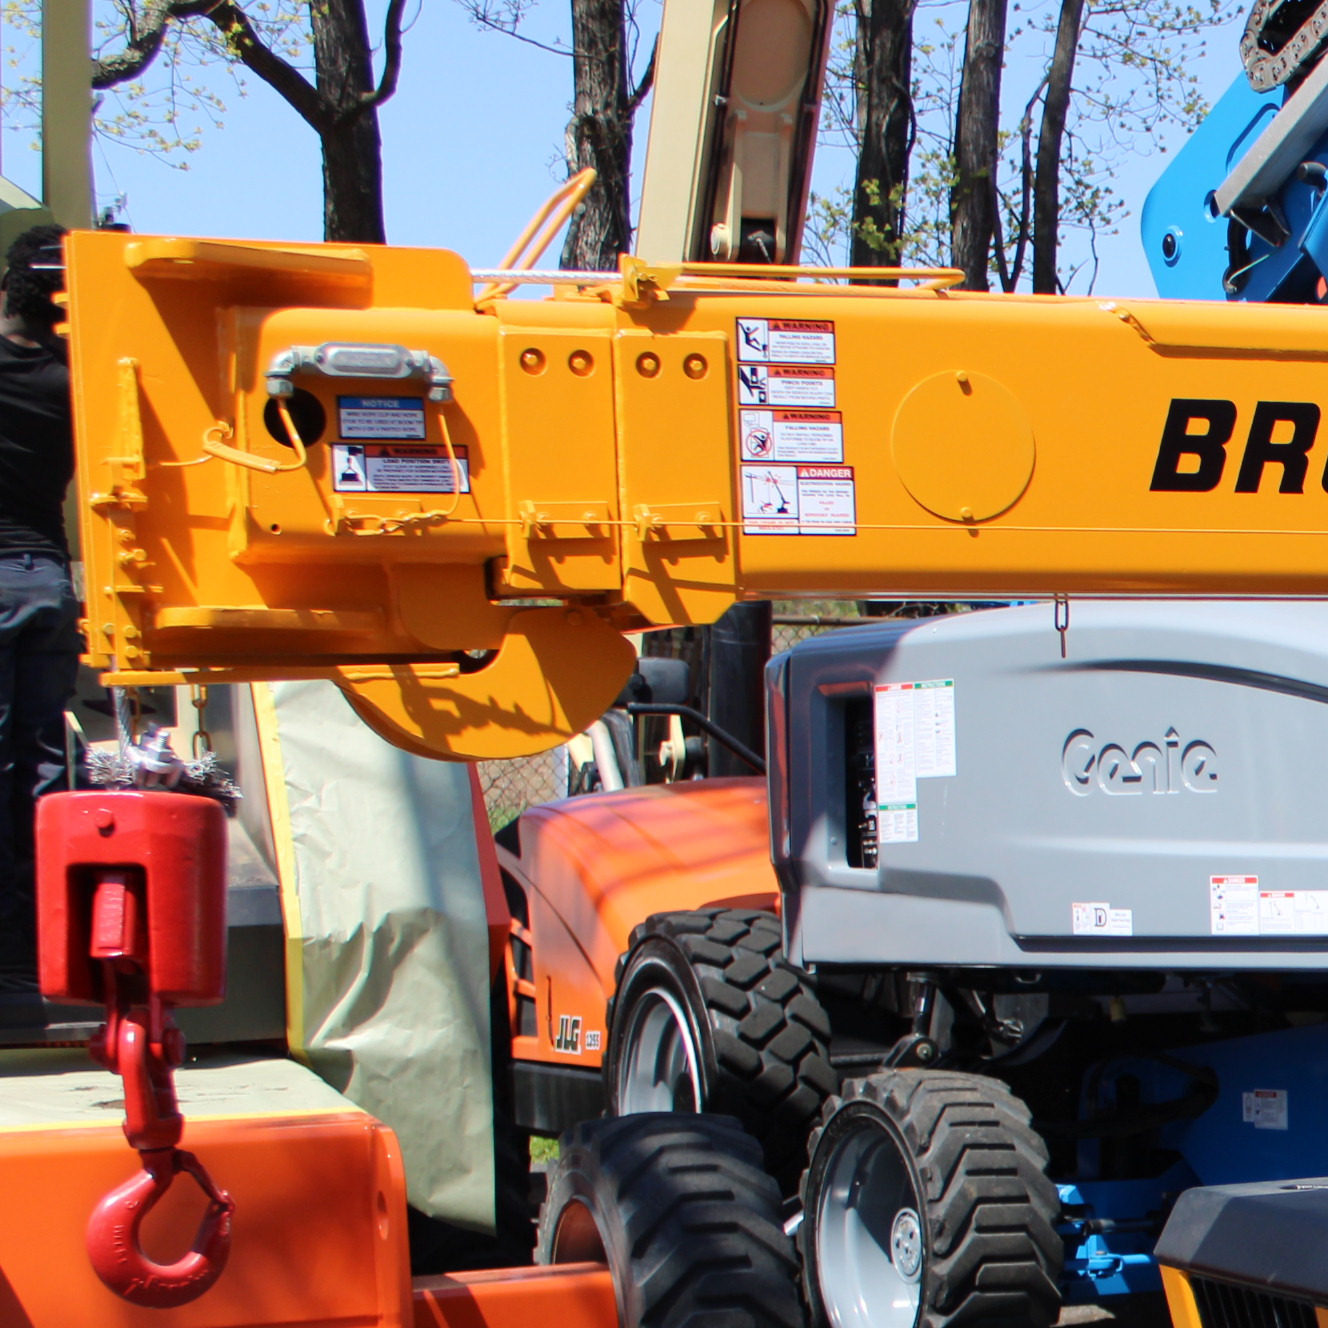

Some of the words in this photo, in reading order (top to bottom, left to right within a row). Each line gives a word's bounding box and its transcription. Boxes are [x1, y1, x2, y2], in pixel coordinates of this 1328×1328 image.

[783, 322, 829, 330] WARNING
[783, 368, 826, 377] WARNING
[362, 399, 400, 408] NOTICE
[809, 468, 852, 478] DANGER
[1062, 726, 1218, 797] Genie
[555, 1015, 582, 1054] JLG
